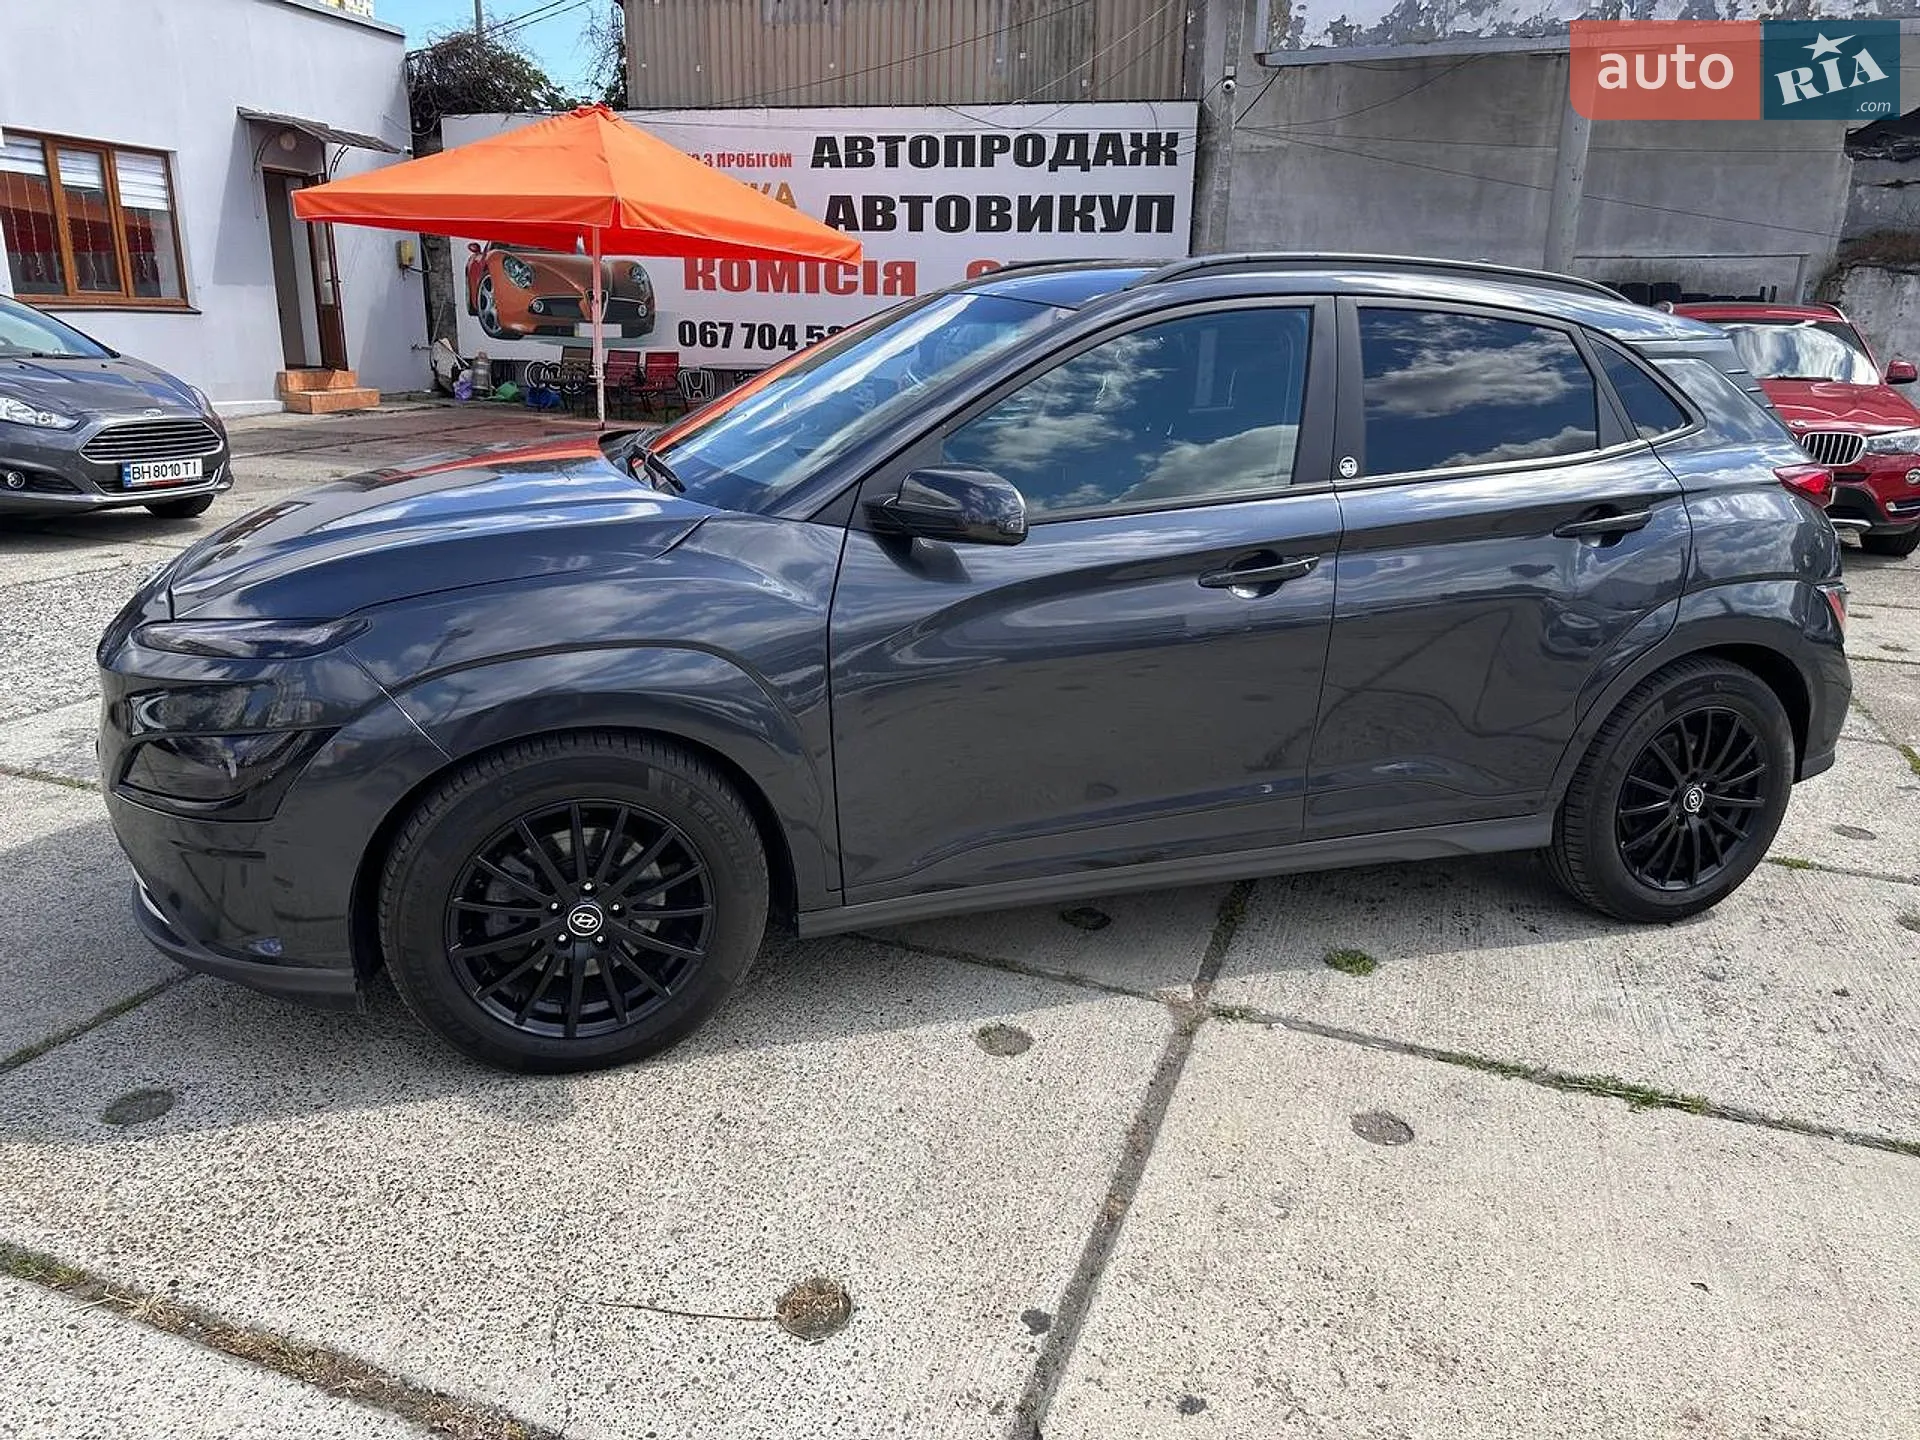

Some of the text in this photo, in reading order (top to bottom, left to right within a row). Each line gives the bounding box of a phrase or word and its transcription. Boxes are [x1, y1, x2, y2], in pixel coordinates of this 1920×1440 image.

[717, 152, 793, 168] ПРОБІГОМ
[810, 132, 1179, 172] АВТОПРОДАЖ
[824, 194, 1175, 233] АВТОВИКУП
[684, 258, 917, 297] КОМІСІЯ
[678, 320, 846, 351] 067 704 5
[132, 465, 151, 480] BH
[153, 463, 180, 478] 8010
